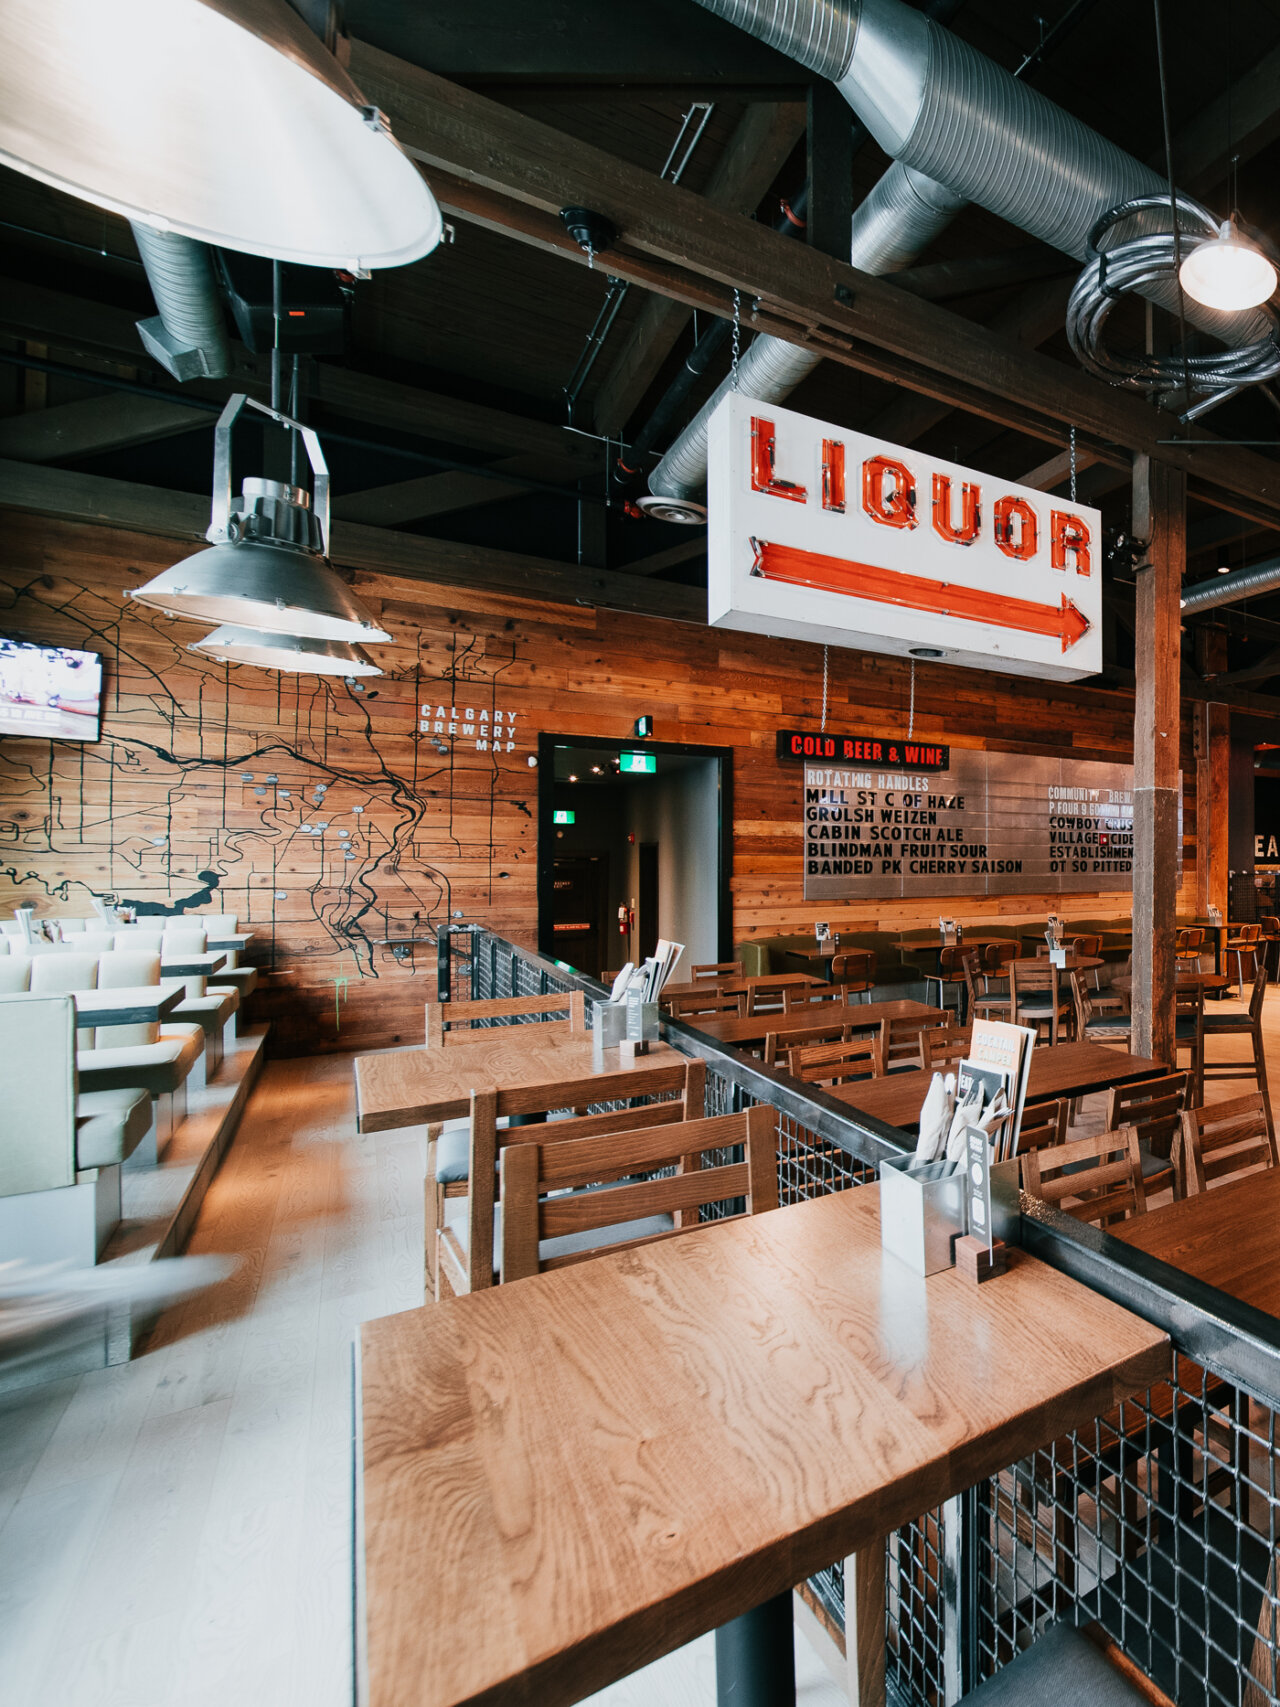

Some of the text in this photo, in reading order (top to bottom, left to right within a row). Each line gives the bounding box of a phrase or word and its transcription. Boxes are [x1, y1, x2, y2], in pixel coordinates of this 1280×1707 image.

[750, 415, 1091, 577] LIQUOR
[421, 704, 517, 723] CALGARY
[420, 720, 516, 738] BREWERY
[475, 739, 516, 752] MAP
[791, 735, 943, 765] COLD BEER & WINE
[807, 769, 929, 791] ROTATING HANDLES
[806, 788, 965, 810] MILL ST C OF HAZE
[1048, 785, 1100, 802] COMMUNITY
[806, 806, 937, 825] GROLSH WEIZEN
[1058, 802, 1079, 815] FOUR
[1049, 816, 1100, 830] COWBOY
[807, 824, 964, 842] CABIN SCOTCH ALE
[1049, 831, 1099, 844] VILLAGE
[808, 842, 987, 858] BLINDMAN FRUIT SOUR
[808, 860, 1023, 875] BANDED PK CHERRY SAISON
[1050, 860, 1132, 873] OT SO PITTED
